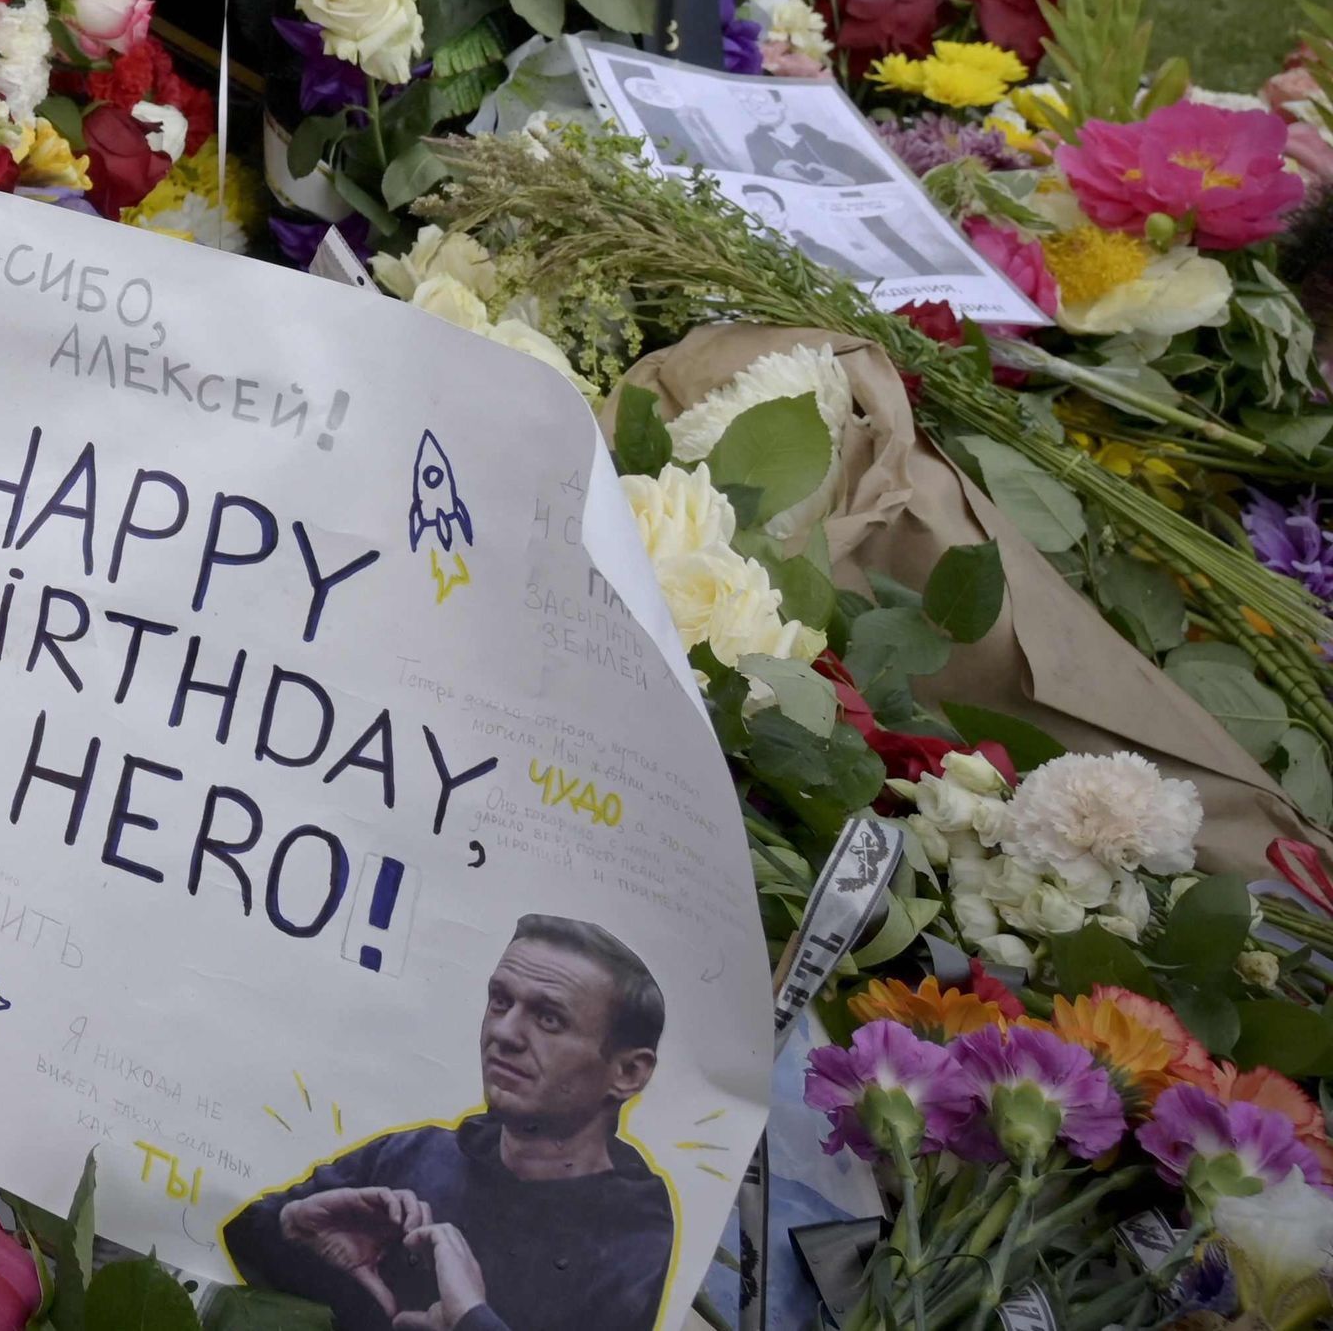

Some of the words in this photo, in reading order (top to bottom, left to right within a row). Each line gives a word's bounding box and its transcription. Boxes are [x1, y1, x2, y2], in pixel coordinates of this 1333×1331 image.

[875, 284, 963, 298] ЖДЕНИЯ,
[49, 323, 350, 453] АЛЕКСЕЙ!
[9, 709, 405, 973] HERO!
[61, 1014, 89, 1055] Я
[132, 1139, 202, 1207] ТЫ
